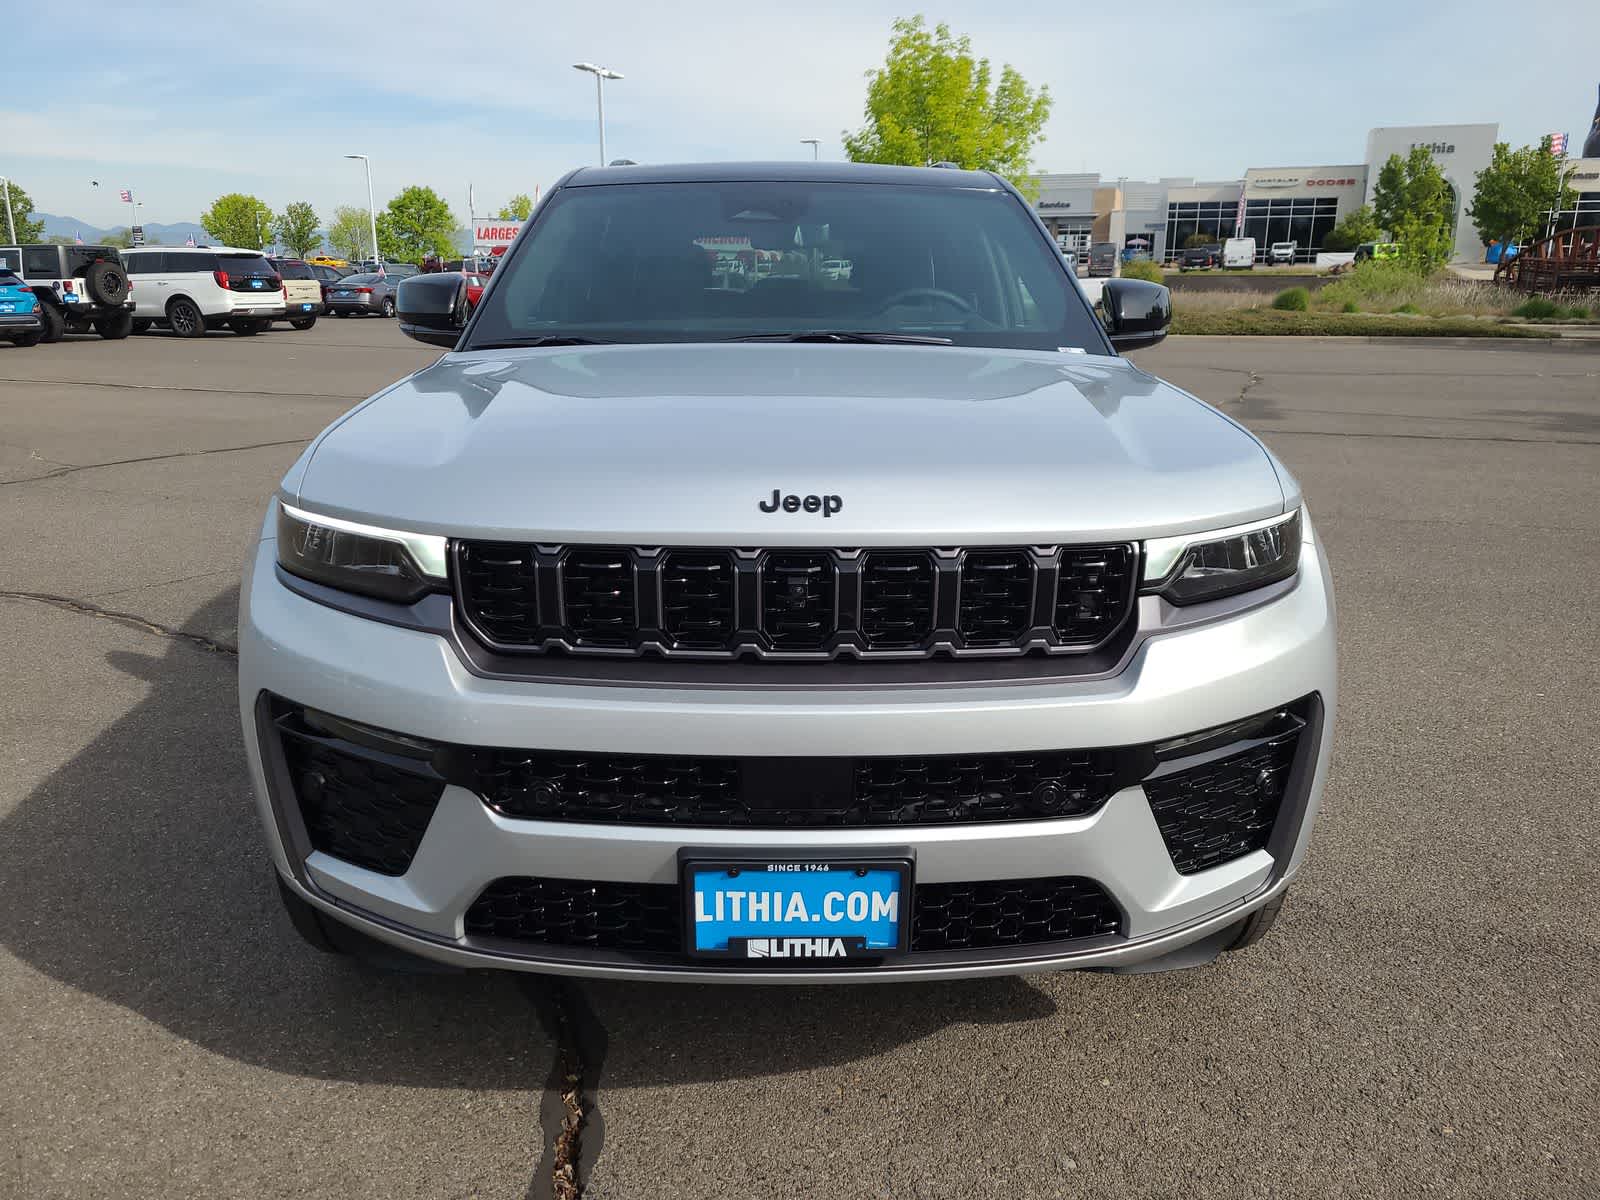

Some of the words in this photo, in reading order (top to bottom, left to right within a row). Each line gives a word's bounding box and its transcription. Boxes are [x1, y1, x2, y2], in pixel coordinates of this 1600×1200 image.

[1306, 178, 1356, 186] DODGE
[759, 489, 843, 518] Jeep
[767, 864, 801, 872] SINCE
[805, 864, 830, 872] 1946
[694, 891, 898, 922] LITHIA.COM
[770, 938, 847, 957] LITHIA
